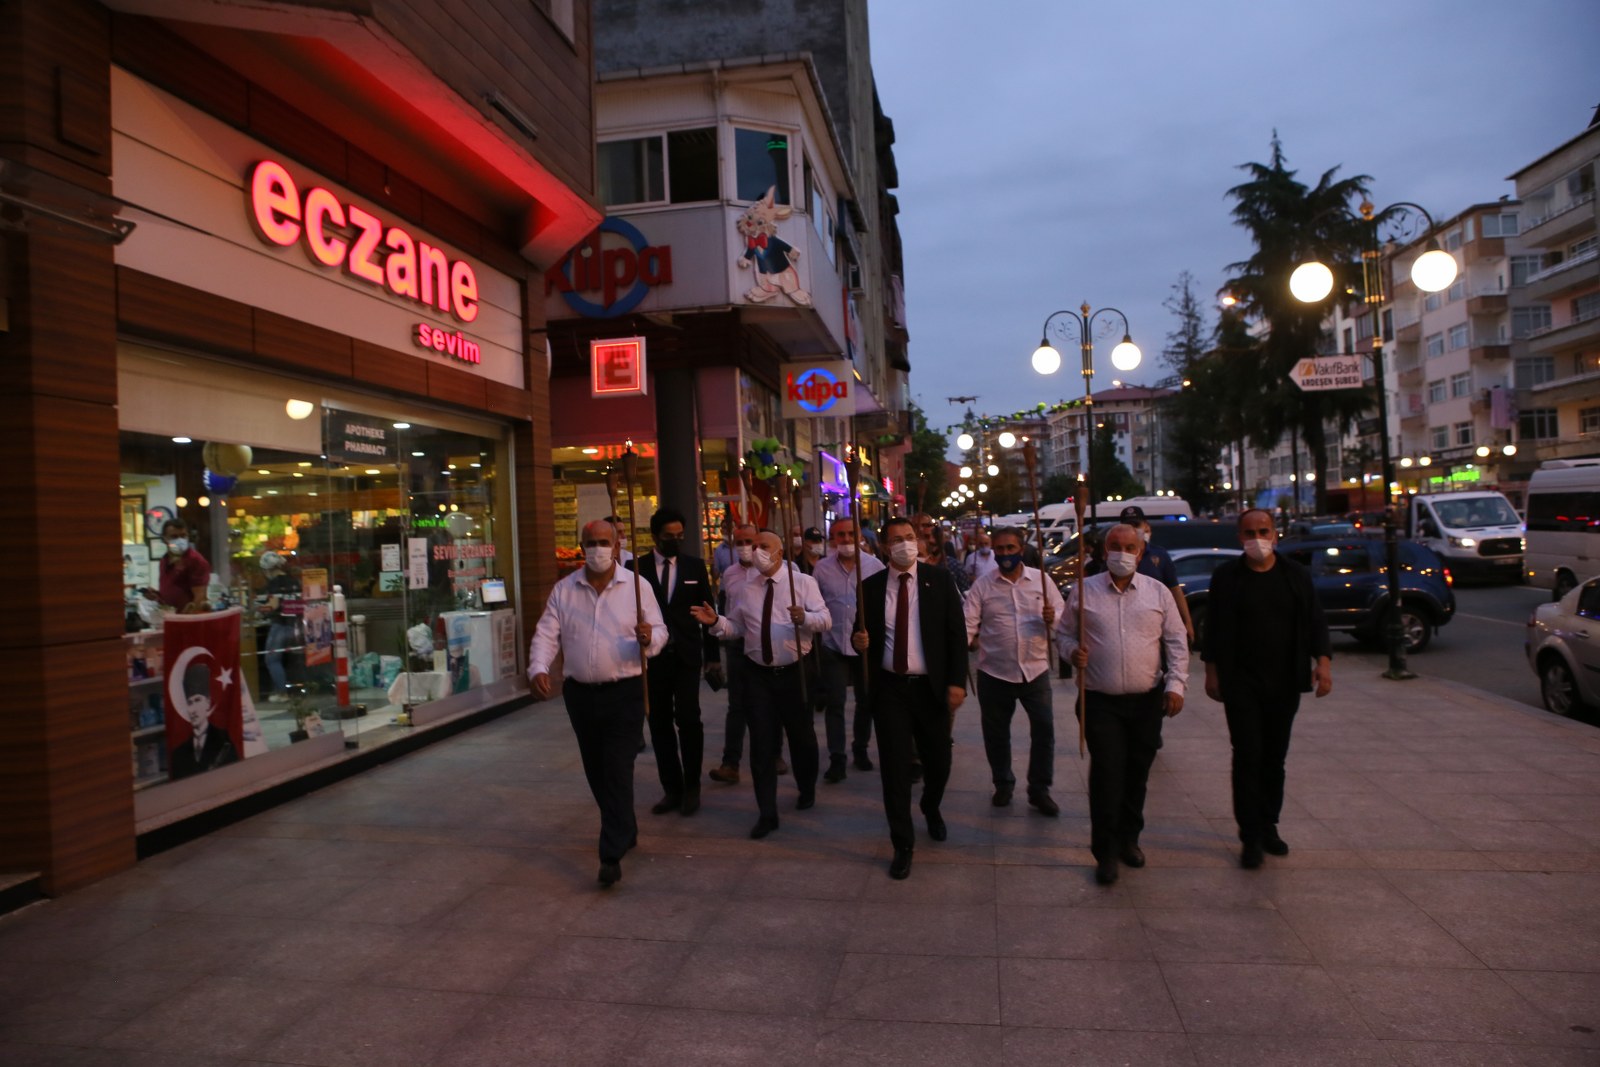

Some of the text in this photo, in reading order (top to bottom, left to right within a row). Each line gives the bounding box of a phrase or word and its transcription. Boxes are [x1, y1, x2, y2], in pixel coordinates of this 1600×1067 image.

[250, 159, 479, 323] eczane
[418, 323, 480, 365] sevim
[604, 350, 631, 385] E
[786, 371, 848, 408] kilpa
[344, 441, 387, 456] PHARMACY
[345, 424, 385, 439] APOTHEKE
